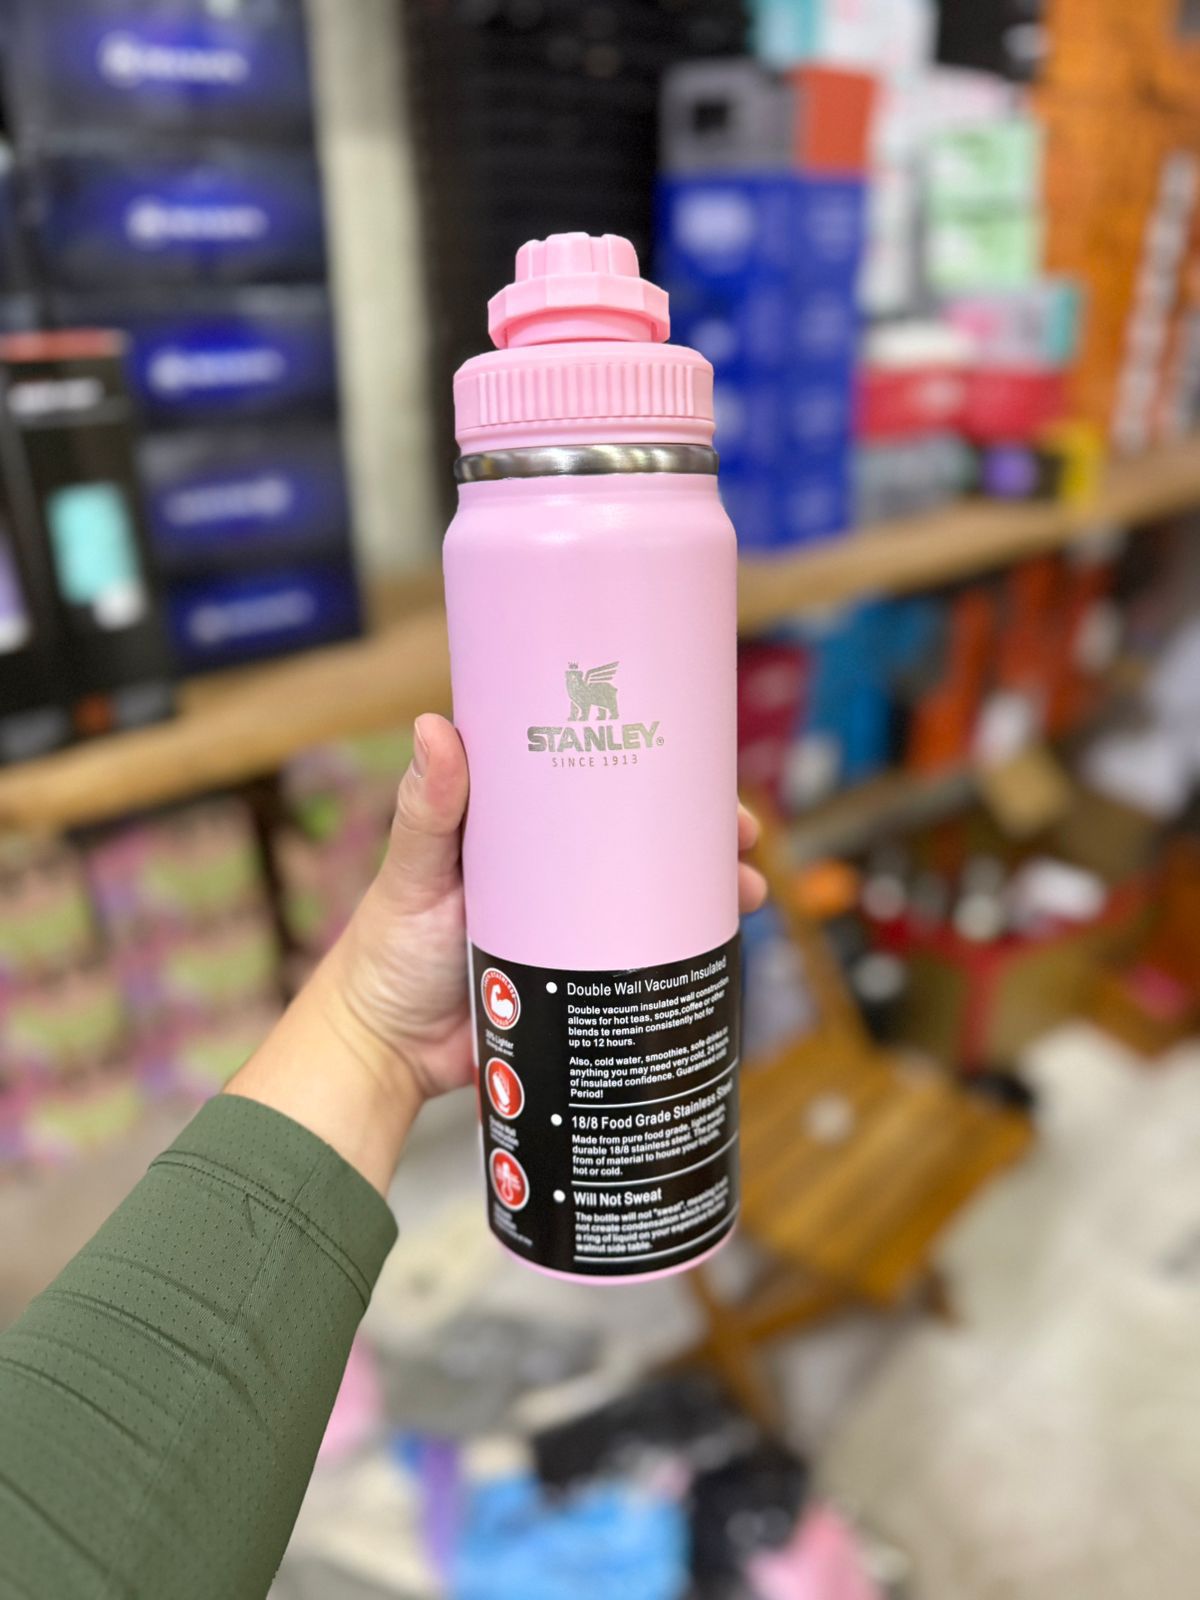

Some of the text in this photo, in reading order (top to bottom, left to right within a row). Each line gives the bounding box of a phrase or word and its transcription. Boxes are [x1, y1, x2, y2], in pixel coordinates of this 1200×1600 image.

[527, 721, 659, 752] STANLEY
[552, 754, 638, 768] SINCE 1913
[567, 955, 726, 996] Double Wall Vacuum Insulated
[568, 1005, 600, 1014] Double
[602, 1005, 638, 1014] vacuum
[641, 999, 678, 1011] insulated
[680, 993, 695, 1003] wall
[568, 1016, 597, 1025] allows
[599, 1015, 611, 1024] for
[614, 1014, 629, 1024] hot
[630, 1013, 652, 1023] teas,
[704, 998, 710, 1006] or
[568, 1027, 599, 1036] blends
[612, 1026, 643, 1036] remain
[646, 1015, 693, 1032] consistently
[695, 1010, 705, 1021] hot
[569, 1038, 635, 1048] up to 12 hours.
[569, 1057, 593, 1067] Also,
[595, 1057, 614, 1066] cold
[616, 1055, 643, 1065] water,
[646, 1046, 689, 1063] smoothies,
[570, 1068, 609, 1078] anything
[611, 1067, 627, 1078] you
[630, 1065, 648, 1076] may
[650, 1060, 671, 1072] need
[673, 1056, 689, 1069] very
[570, 1078, 580, 1087] of
[581, 1077, 622, 1088] insulated
[570, 1089, 604, 1098] Period!
[572, 1116, 598, 1129] 18/8
[601, 1115, 632, 1129] Food
[635, 1112, 672, 1127] Grade
[673, 1095, 715, 1119] Stainless
[572, 1134, 597, 1144] Made
[599, 1135, 620, 1144] from
[622, 1134, 643, 1145] pure
[645, 1129, 663, 1141] food
[572, 1145, 607, 1155] durable
[610, 1145, 629, 1154] 18/8
[632, 1140, 669, 1153] stainless
[573, 1156, 593, 1165] from
[596, 1156, 605, 1165] of
[607, 1154, 644, 1165] material
[645, 1153, 654, 1162] to
[656, 1145, 681, 1160] house
[573, 1166, 588, 1175] hot
[601, 1167, 623, 1175] cold.
[574, 1188, 662, 1206] Will Not Sweat
[575, 1212, 592, 1222] The
[594, 1212, 619, 1222] bottle
[591, 1223, 620, 1232] create
[583, 1233, 601, 1244] ring
